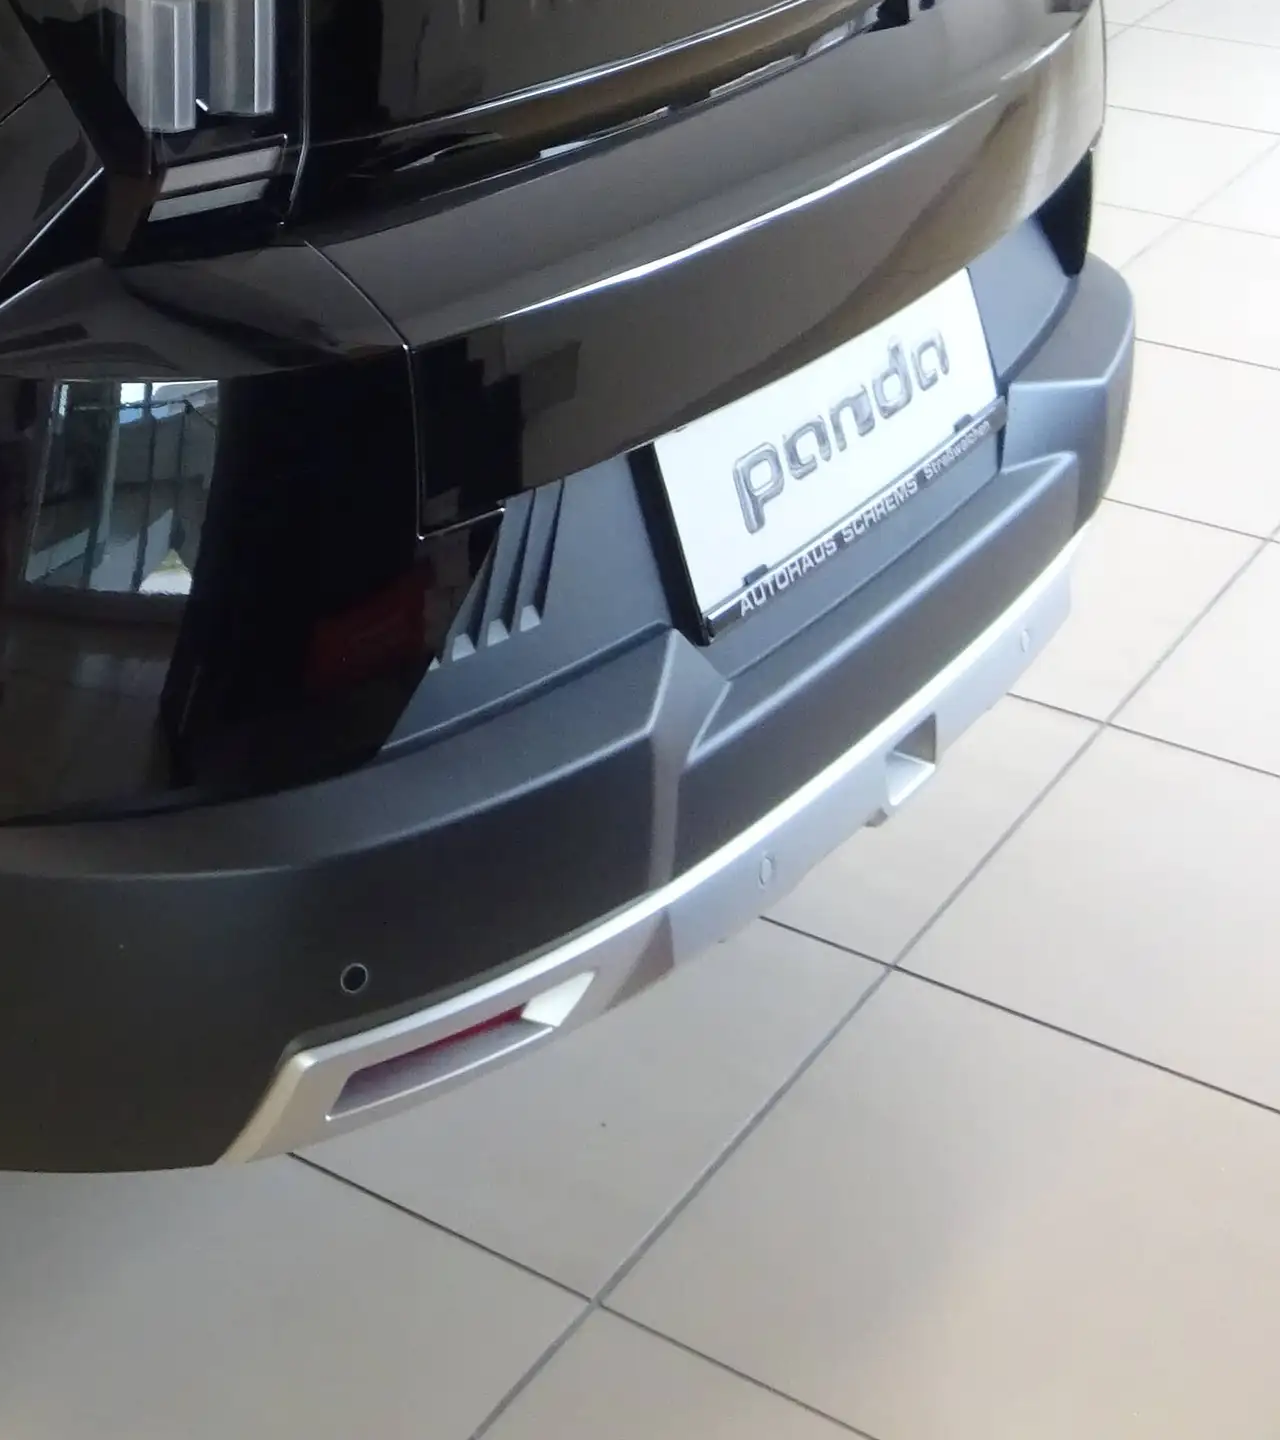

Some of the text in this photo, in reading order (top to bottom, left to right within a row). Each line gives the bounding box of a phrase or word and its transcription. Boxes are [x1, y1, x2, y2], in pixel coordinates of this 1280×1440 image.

[731, 327, 951, 536] panda
[739, 536, 838, 617] AUTOHAUS
[841, 474, 919, 543] SCHREMS
